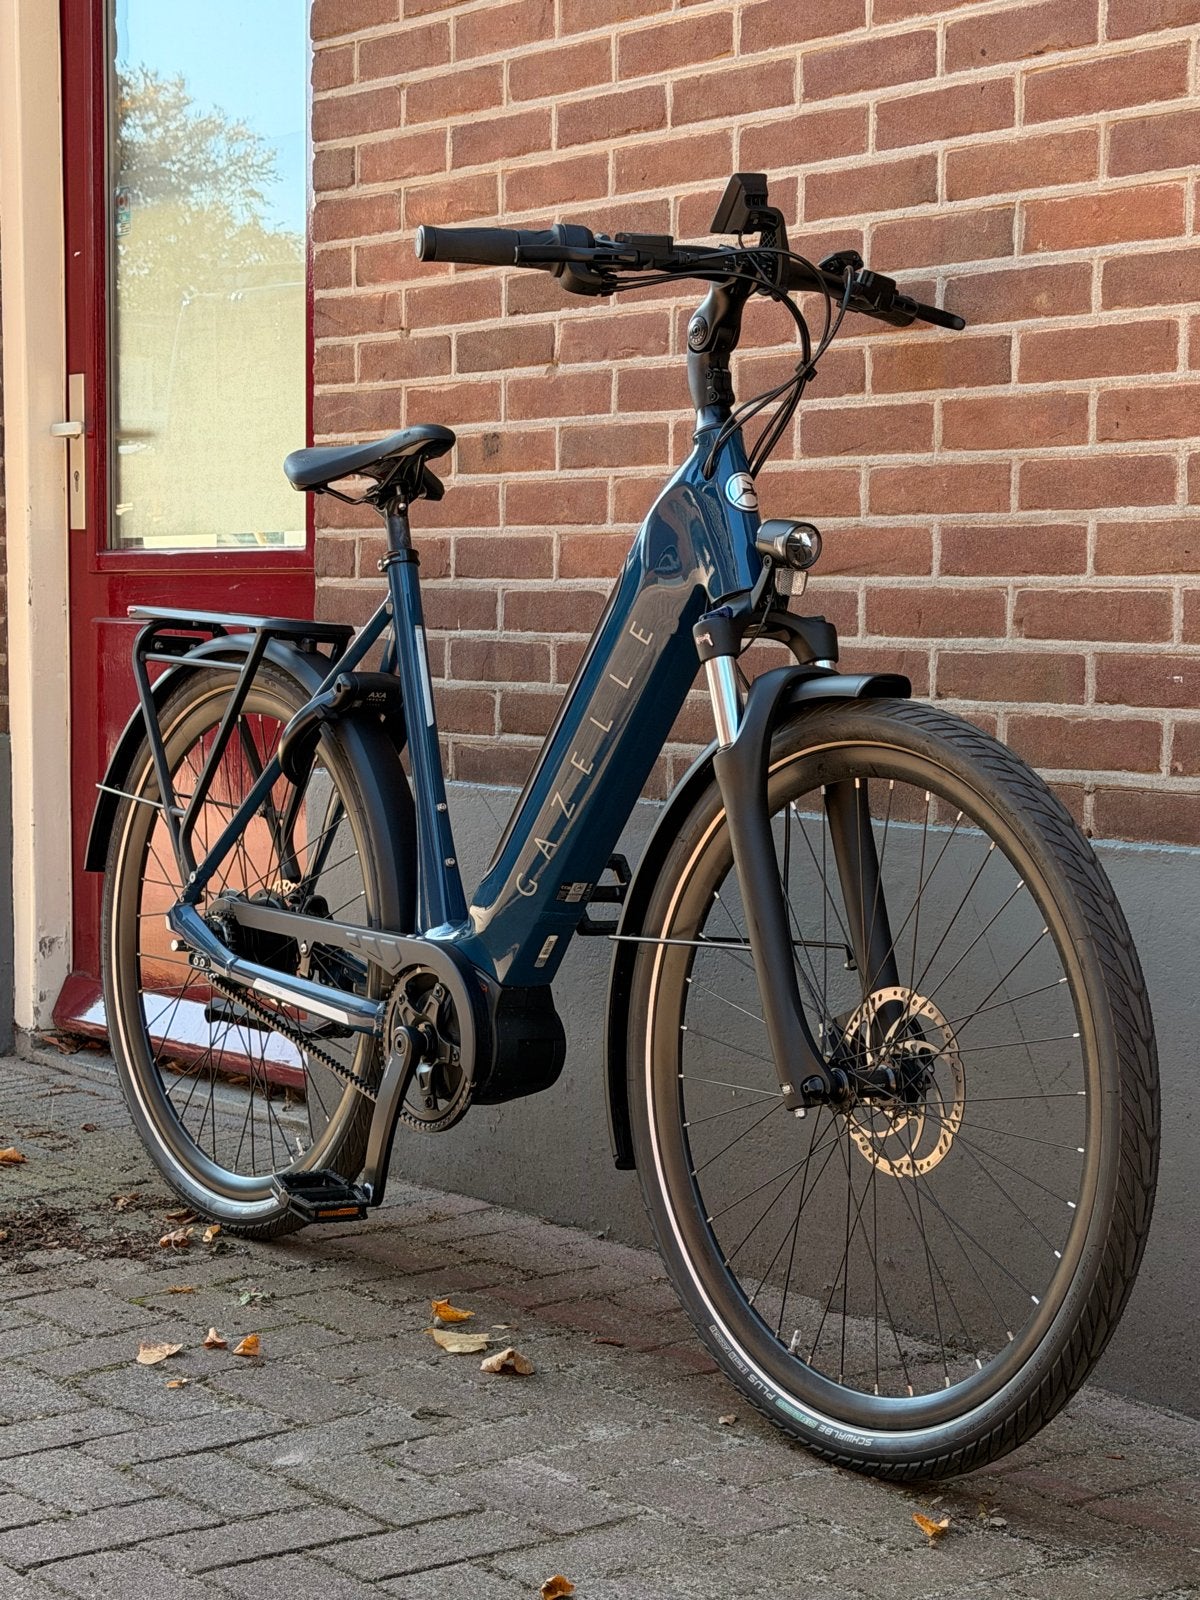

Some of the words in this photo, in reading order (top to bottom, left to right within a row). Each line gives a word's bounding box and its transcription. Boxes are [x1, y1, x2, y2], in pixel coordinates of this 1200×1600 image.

[368, 691, 387, 699] AXA
[515, 621, 653, 897] GAZELLE
[747, 1374, 776, 1401] PLUS
[818, 1424, 874, 1447] SCHWALBE
